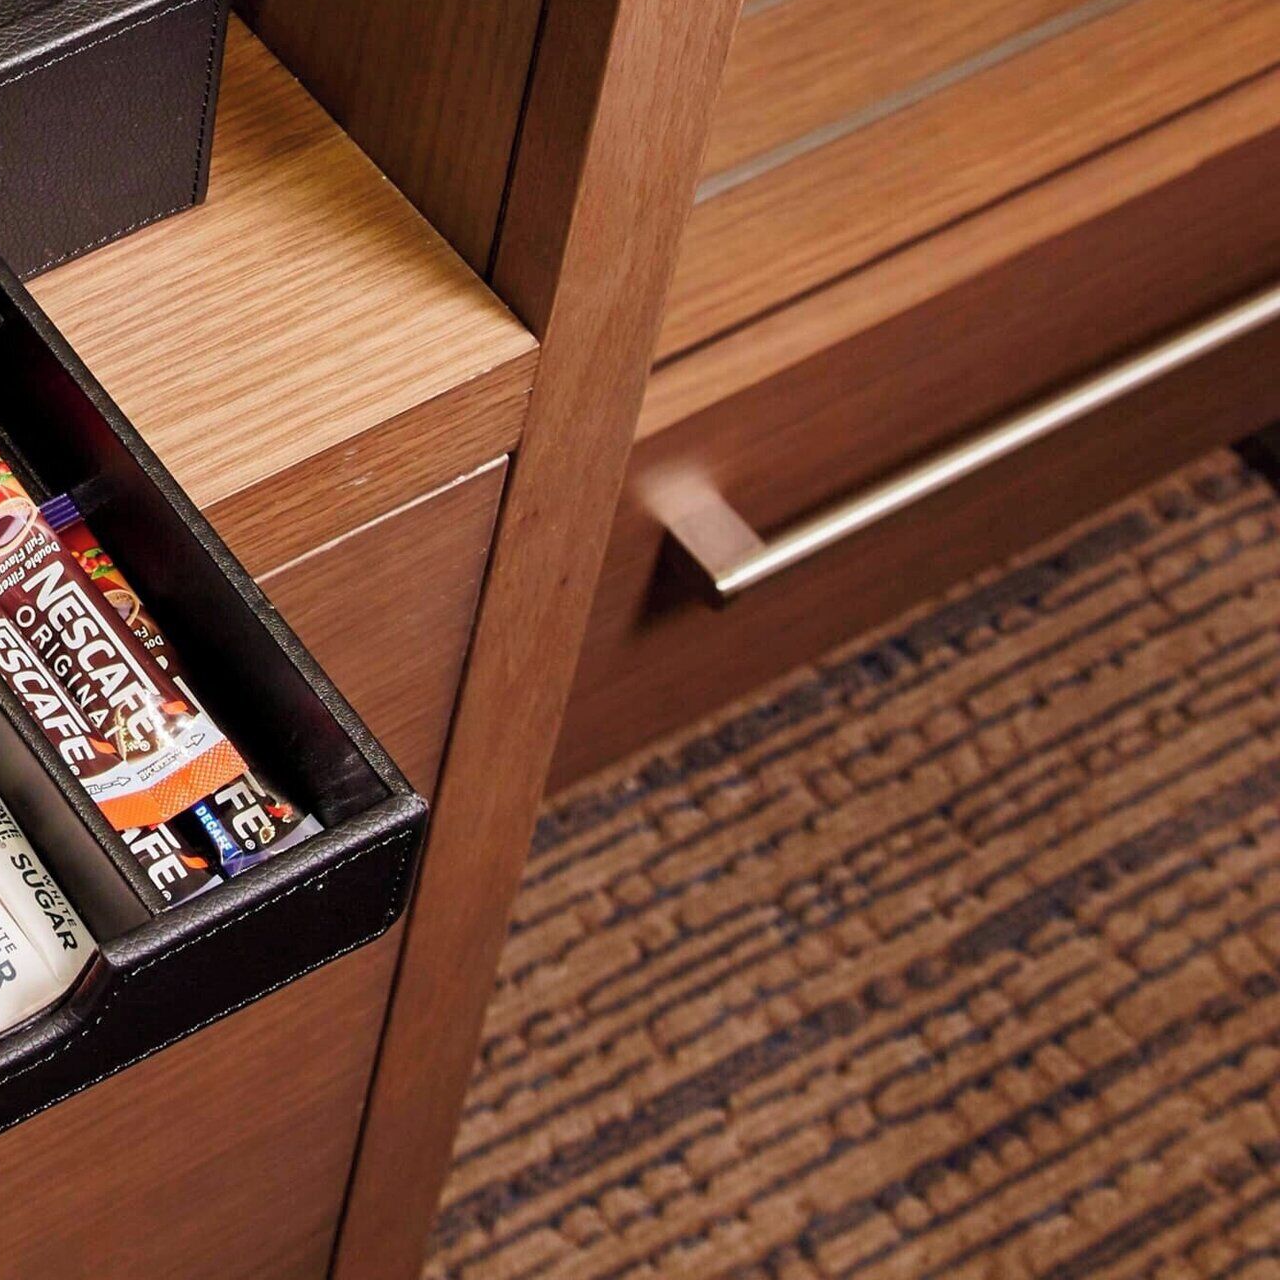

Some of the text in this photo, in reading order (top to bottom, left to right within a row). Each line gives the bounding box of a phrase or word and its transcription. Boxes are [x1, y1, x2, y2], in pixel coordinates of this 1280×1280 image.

[23, 533, 44, 558] Full
[26, 541, 61, 571] Double
[10, 852, 78, 951] SUGAR
[42, 874, 78, 928] WHITE
